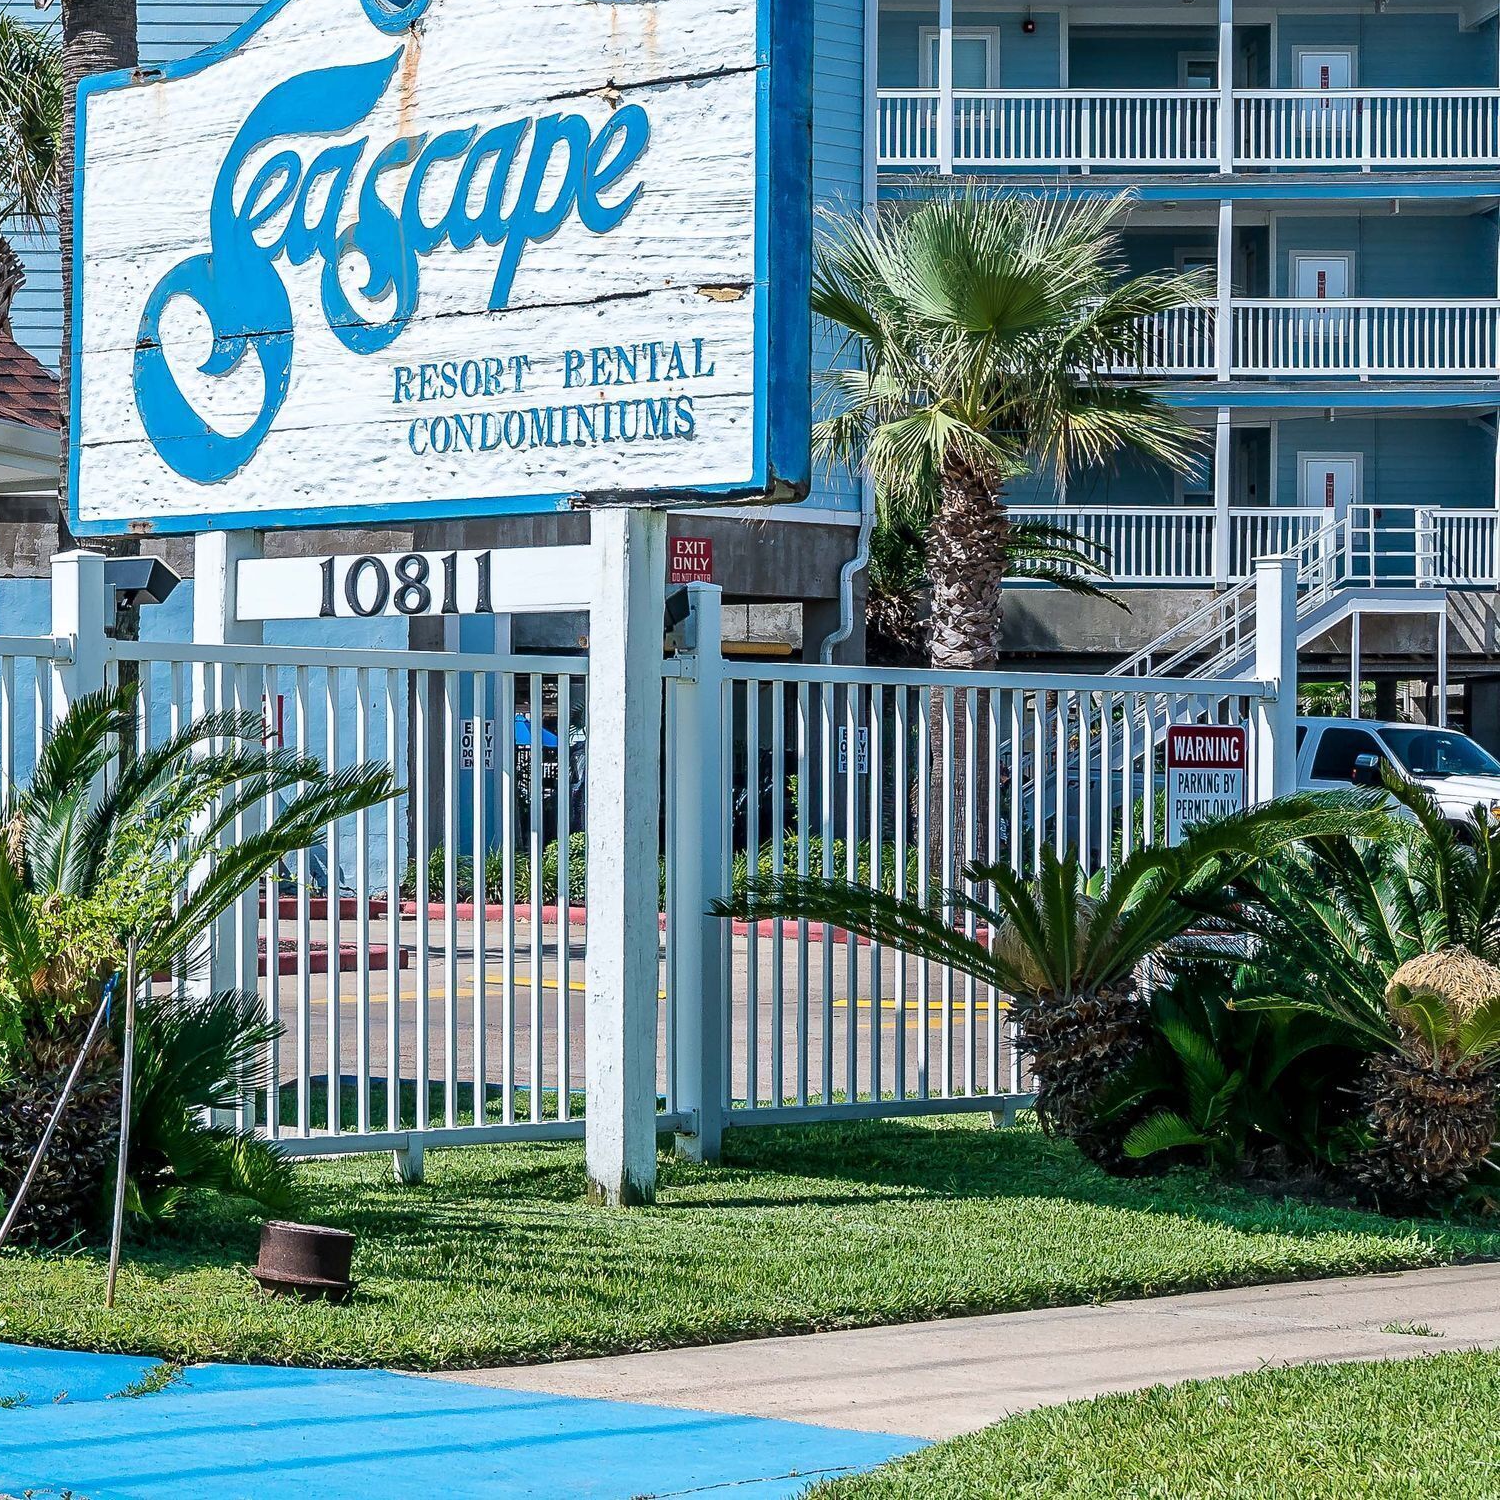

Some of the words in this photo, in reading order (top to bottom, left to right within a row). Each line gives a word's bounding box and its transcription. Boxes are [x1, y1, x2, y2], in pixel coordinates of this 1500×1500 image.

[133, 44, 650, 485] Seascape
[392, 355, 532, 404] RESORT
[562, 338, 716, 389] RENTAL
[408, 394, 696, 456] CONDOMINIUMS
[676, 540, 706, 555] EXIT
[673, 556, 710, 571] ONLY
[319, 550, 494, 618] 10811
[671, 572, 681, 582] DO
[1173, 735, 1240, 762] WARNING
[1178, 772, 1220, 794] PARKING
[1223, 773, 1236, 794] BY
[1175, 798, 1211, 820] PERMIT
